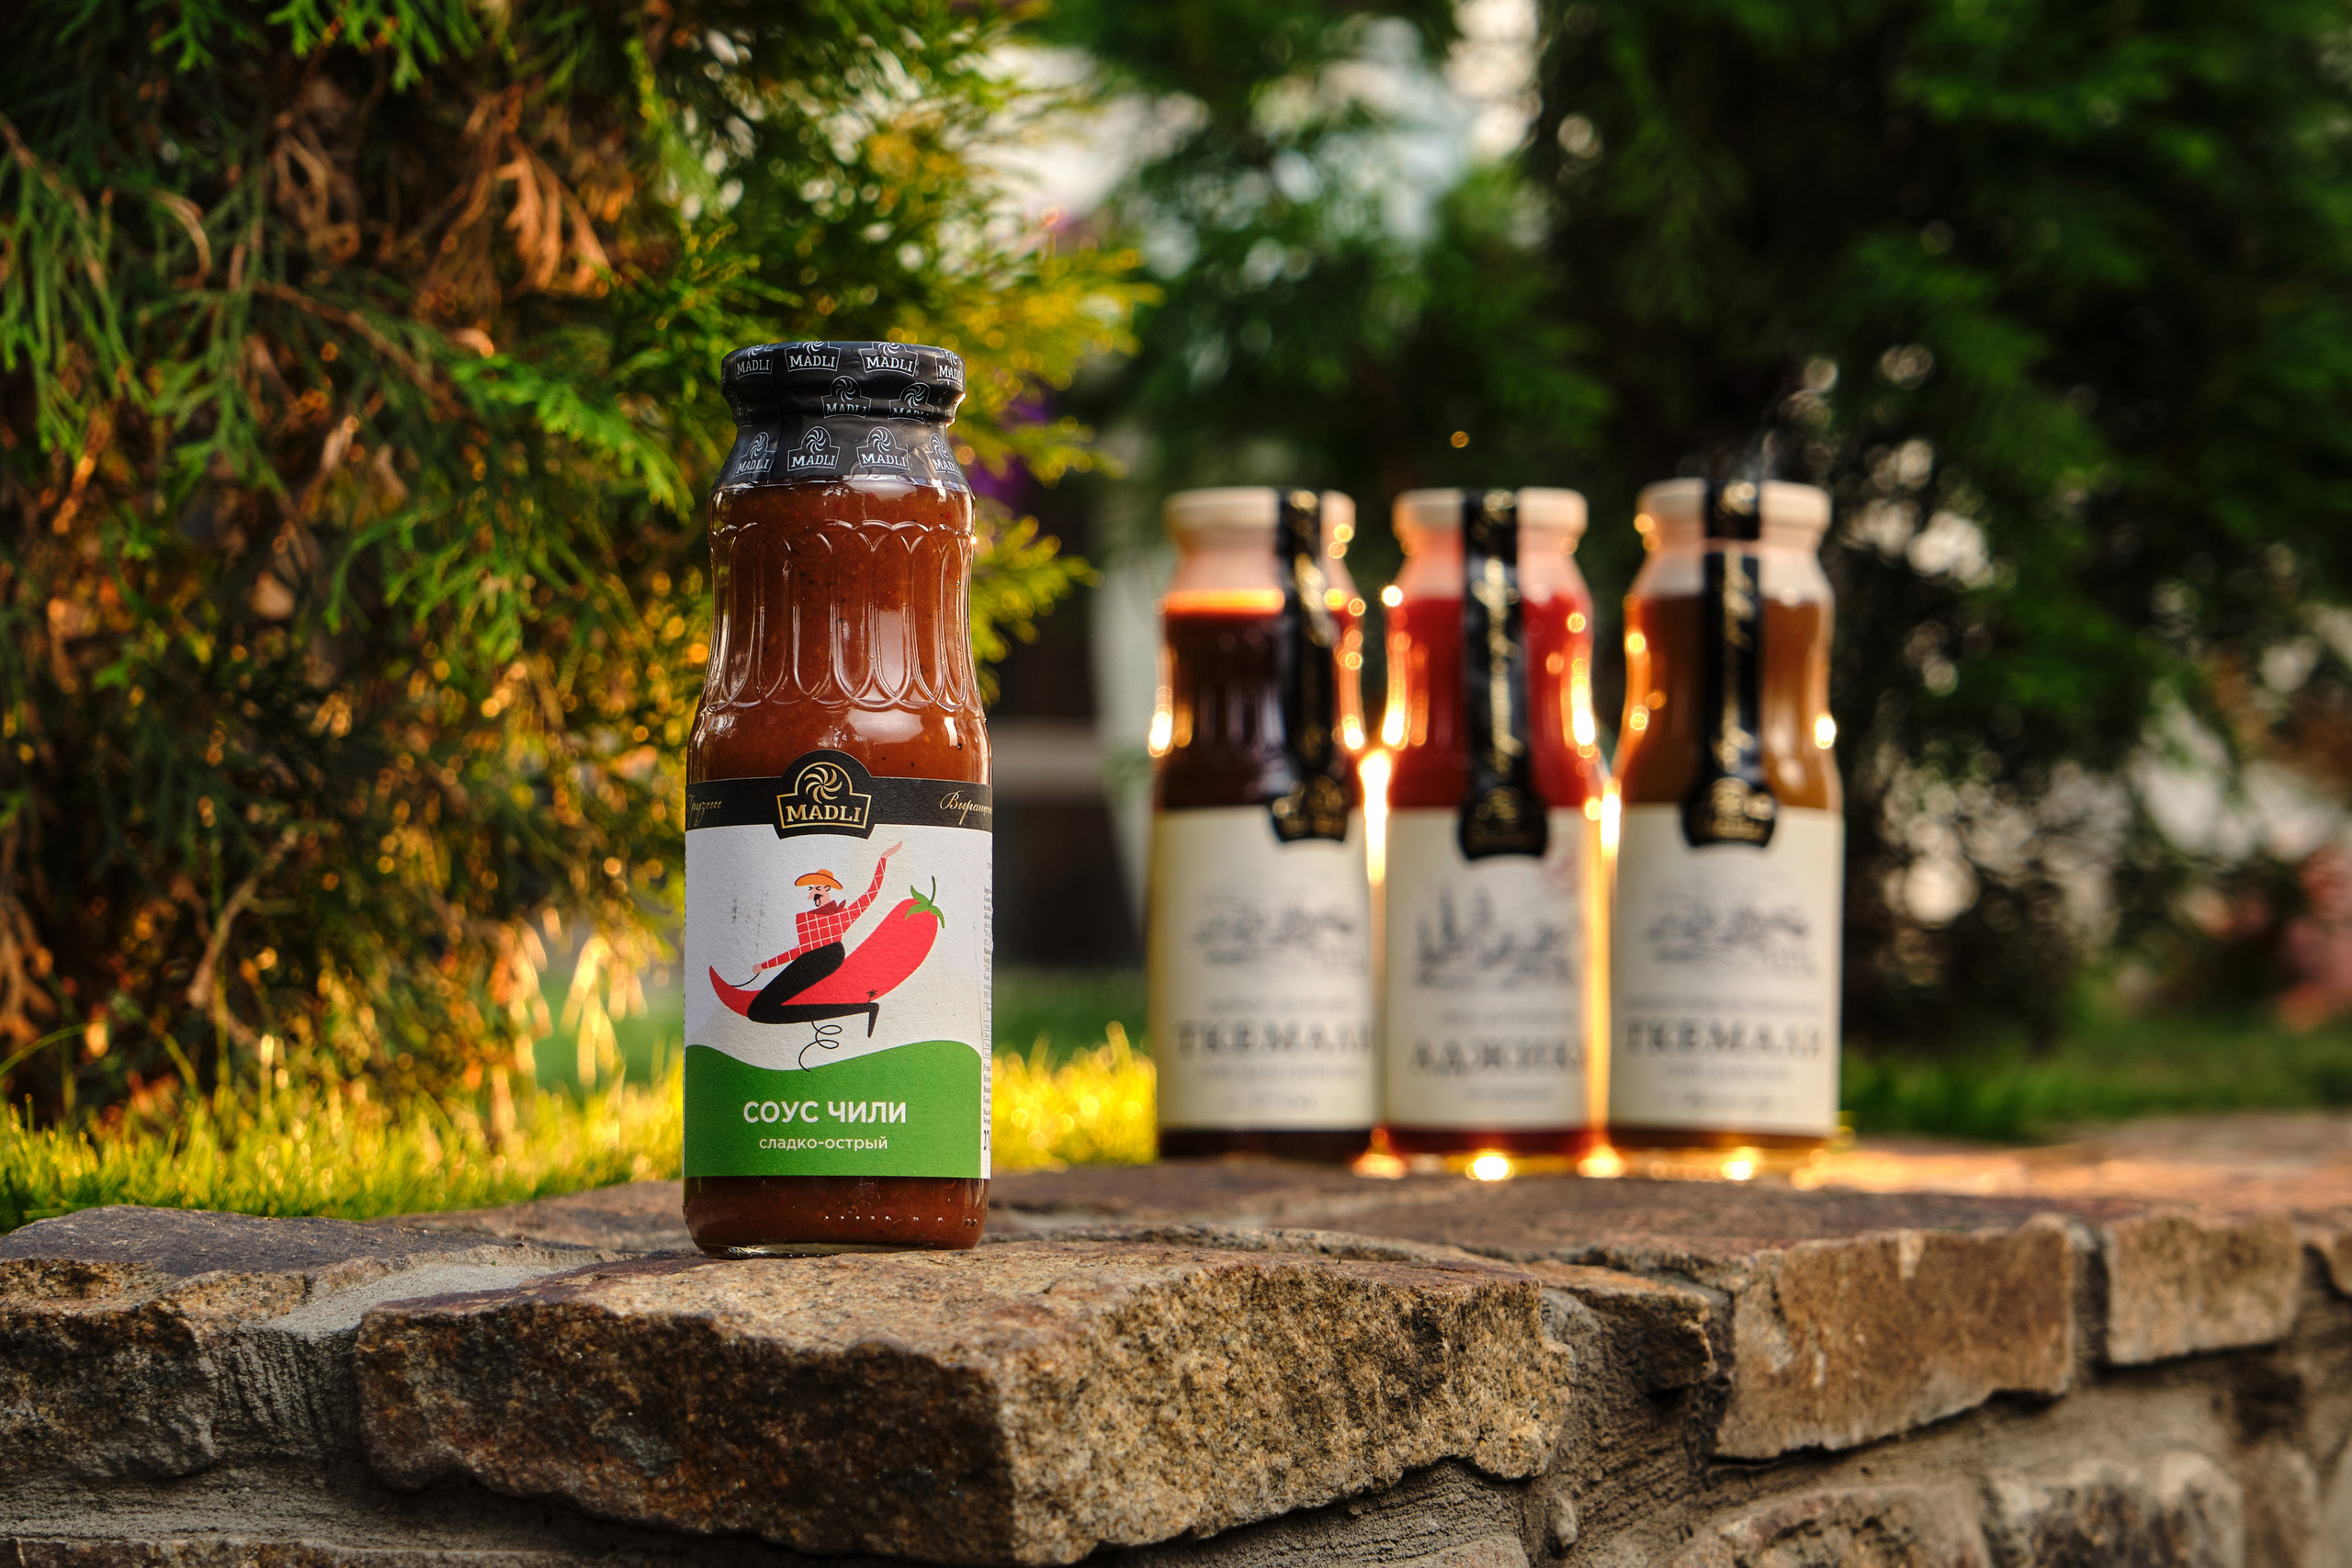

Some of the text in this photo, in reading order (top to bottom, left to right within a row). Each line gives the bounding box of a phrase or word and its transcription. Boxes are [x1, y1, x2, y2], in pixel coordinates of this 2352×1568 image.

[737, 359, 770, 375] MADLI
[787, 354, 836, 368] MADLI
[865, 355, 914, 373] MADLI
[938, 365, 964, 384] MADLI
[736, 458, 770, 474] MADLI
[791, 454, 836, 468] MADLI
[861, 453, 907, 468] MADLI
[786, 803, 862, 824] MADLI
[743, 1100, 907, 1123] СОУС ЧИЛИ
[759, 1135, 888, 1151] сладко-острый
